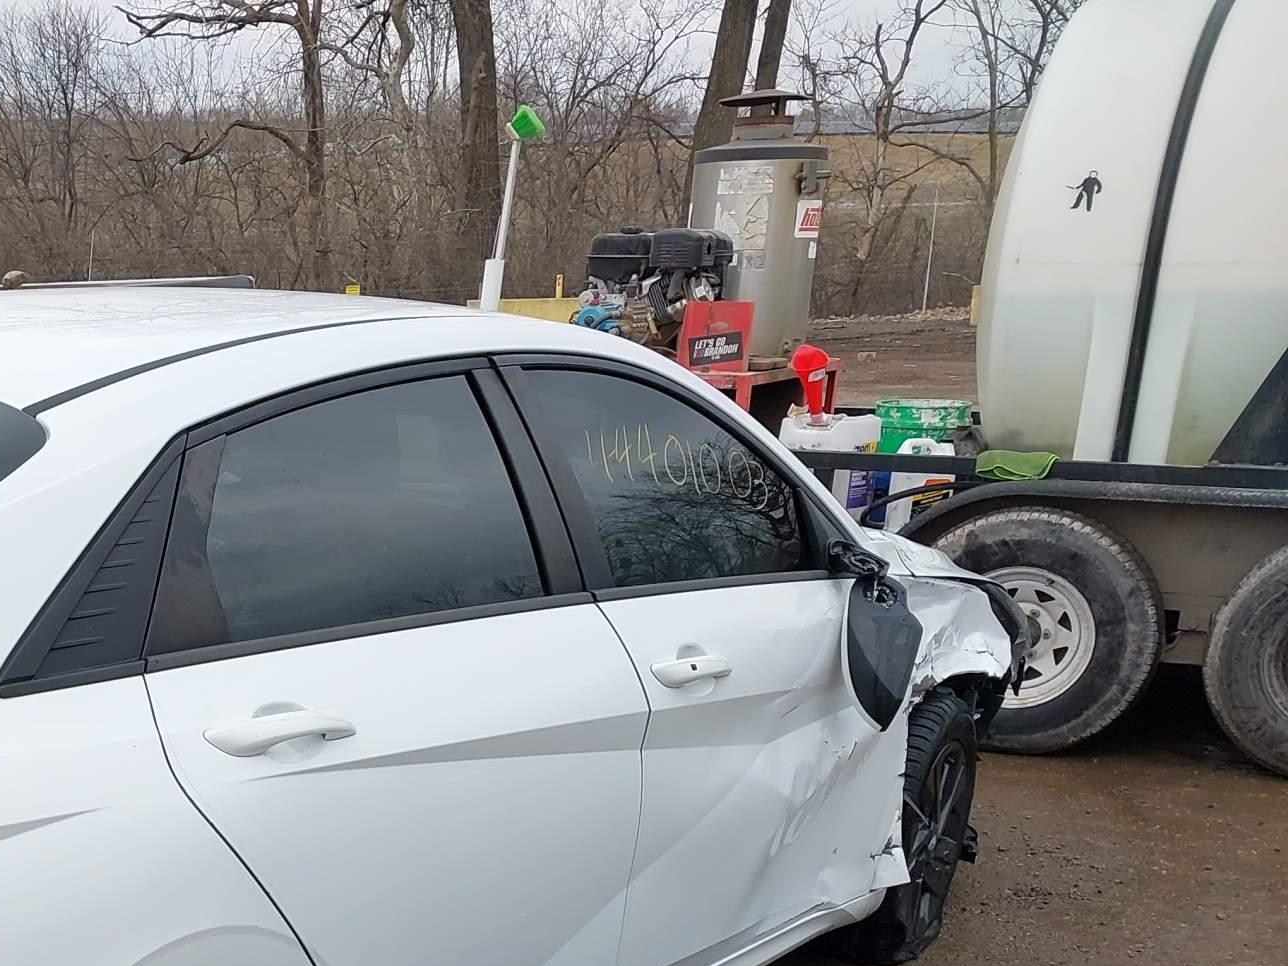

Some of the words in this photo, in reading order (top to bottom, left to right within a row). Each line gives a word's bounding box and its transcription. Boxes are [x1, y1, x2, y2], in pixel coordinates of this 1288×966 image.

[695, 338, 714, 349] LET'S
[716, 337, 726, 346] GO
[704, 344, 739, 357] BRANDON
